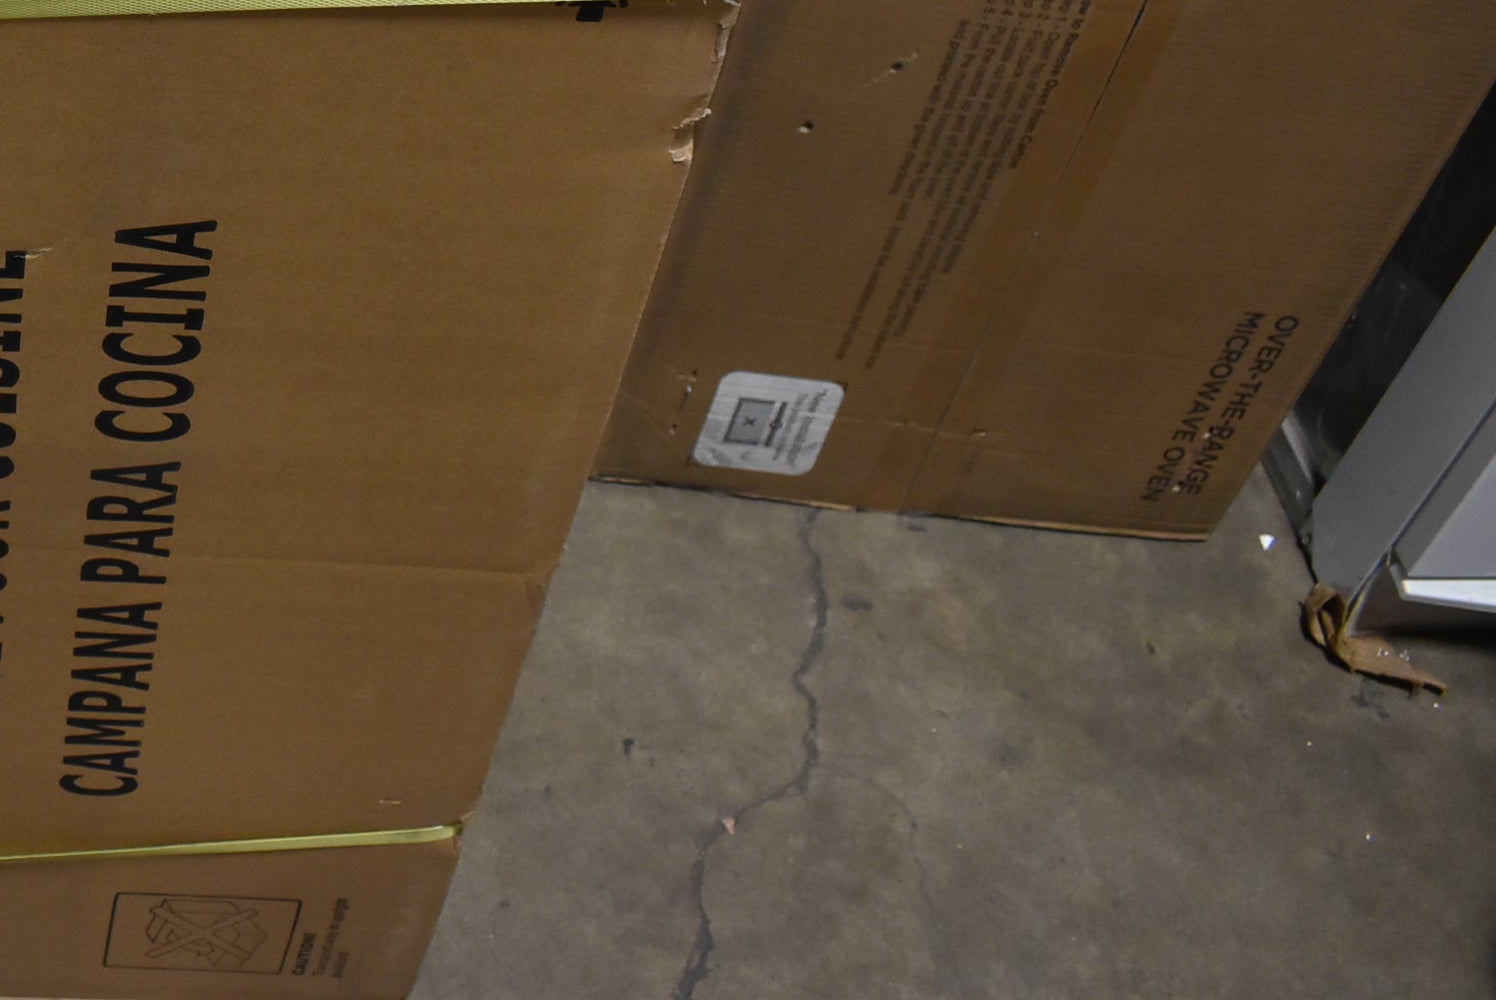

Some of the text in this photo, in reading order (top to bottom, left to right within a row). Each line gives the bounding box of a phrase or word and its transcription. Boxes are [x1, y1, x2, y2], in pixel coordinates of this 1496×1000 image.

[1139, 310, 1265, 502] MICROWAVE OVEN
[1172, 314, 1299, 496] OVER-THE-RANGE
[59, 219, 218, 797] CAMPANA PARA COCINA
